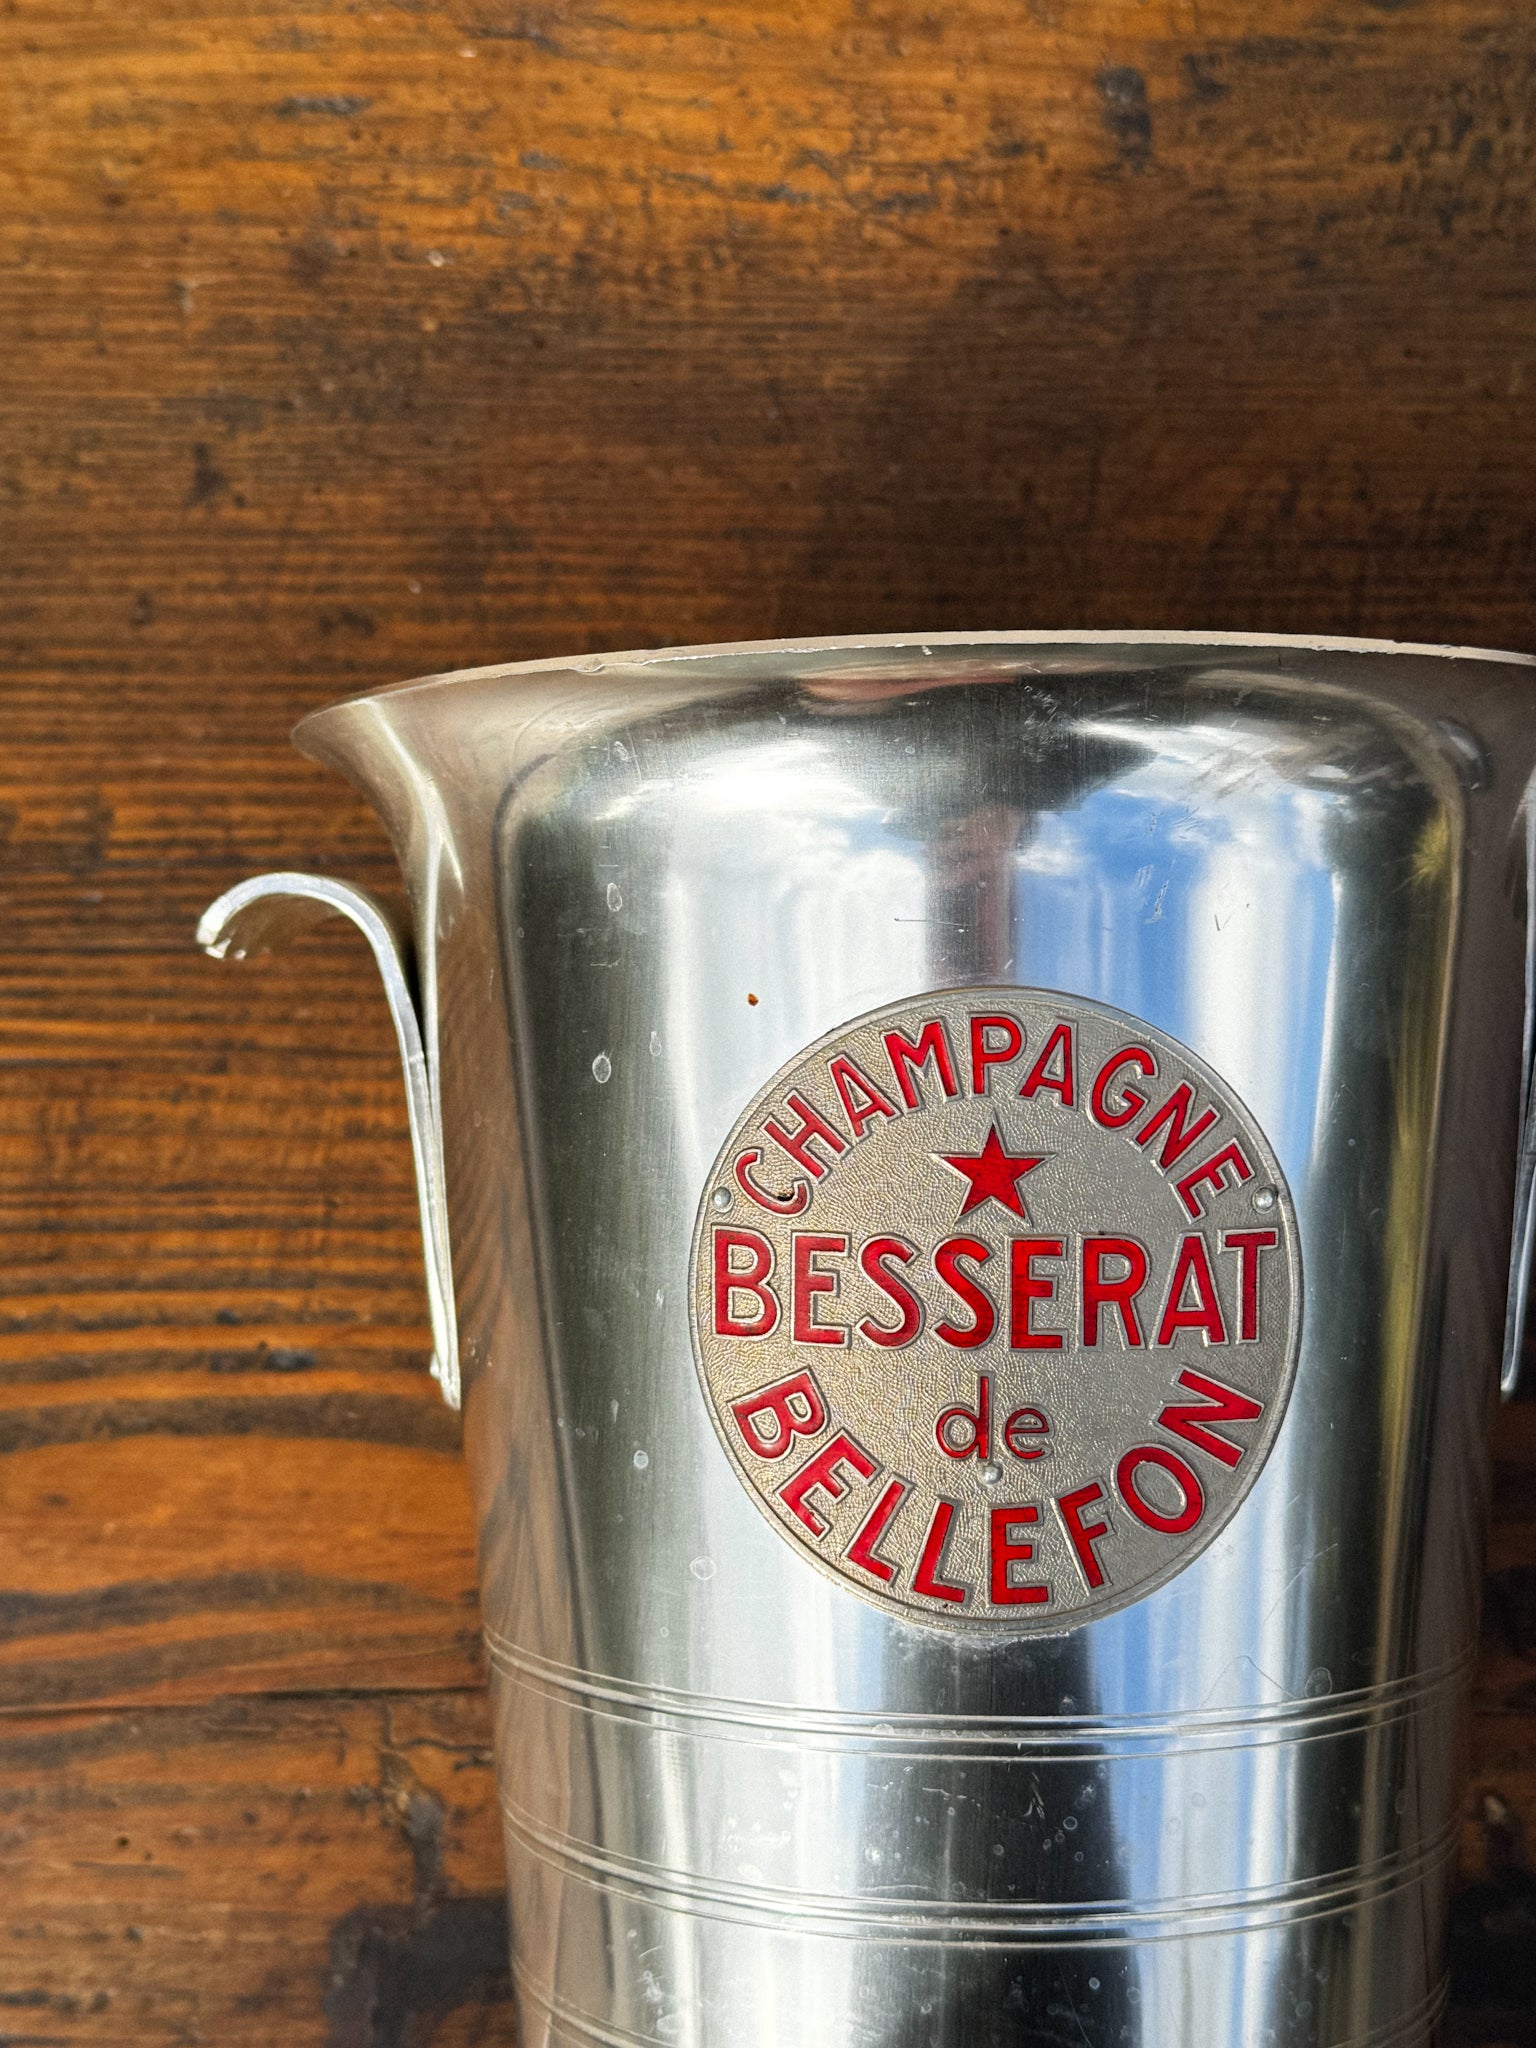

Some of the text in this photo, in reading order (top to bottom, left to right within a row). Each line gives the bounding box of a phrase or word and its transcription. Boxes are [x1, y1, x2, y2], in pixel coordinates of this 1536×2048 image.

[734, 1014, 1253, 1219] CHAMPAGNE
[712, 1228, 1278, 1350] BESSERAT
[731, 1369, 1263, 1606] BELLEFON
[934, 1373, 1053, 1462] de
